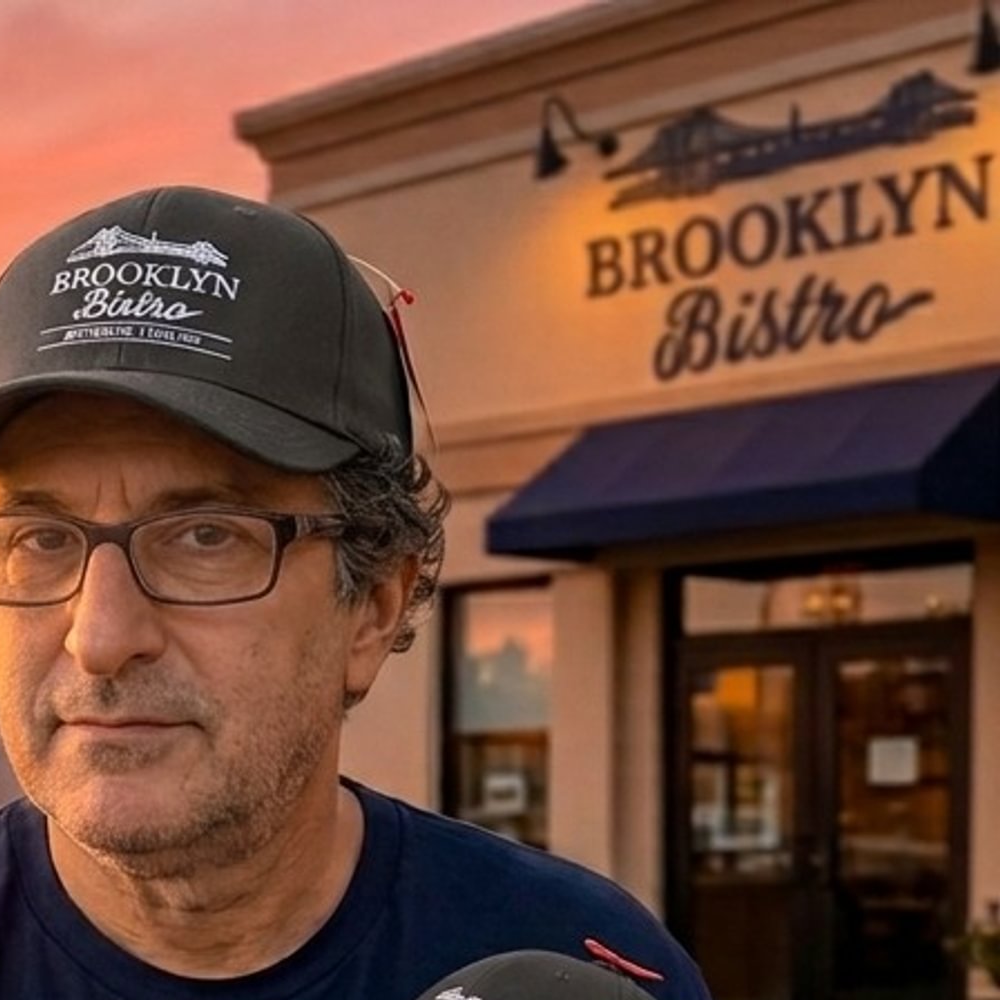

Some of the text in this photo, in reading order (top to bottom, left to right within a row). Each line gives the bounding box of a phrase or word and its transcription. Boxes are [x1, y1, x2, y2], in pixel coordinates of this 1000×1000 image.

[586, 153, 995, 299] BROOKLYN
[50, 261, 241, 301] BROOKLYN
[653, 273, 935, 382] Bistro
